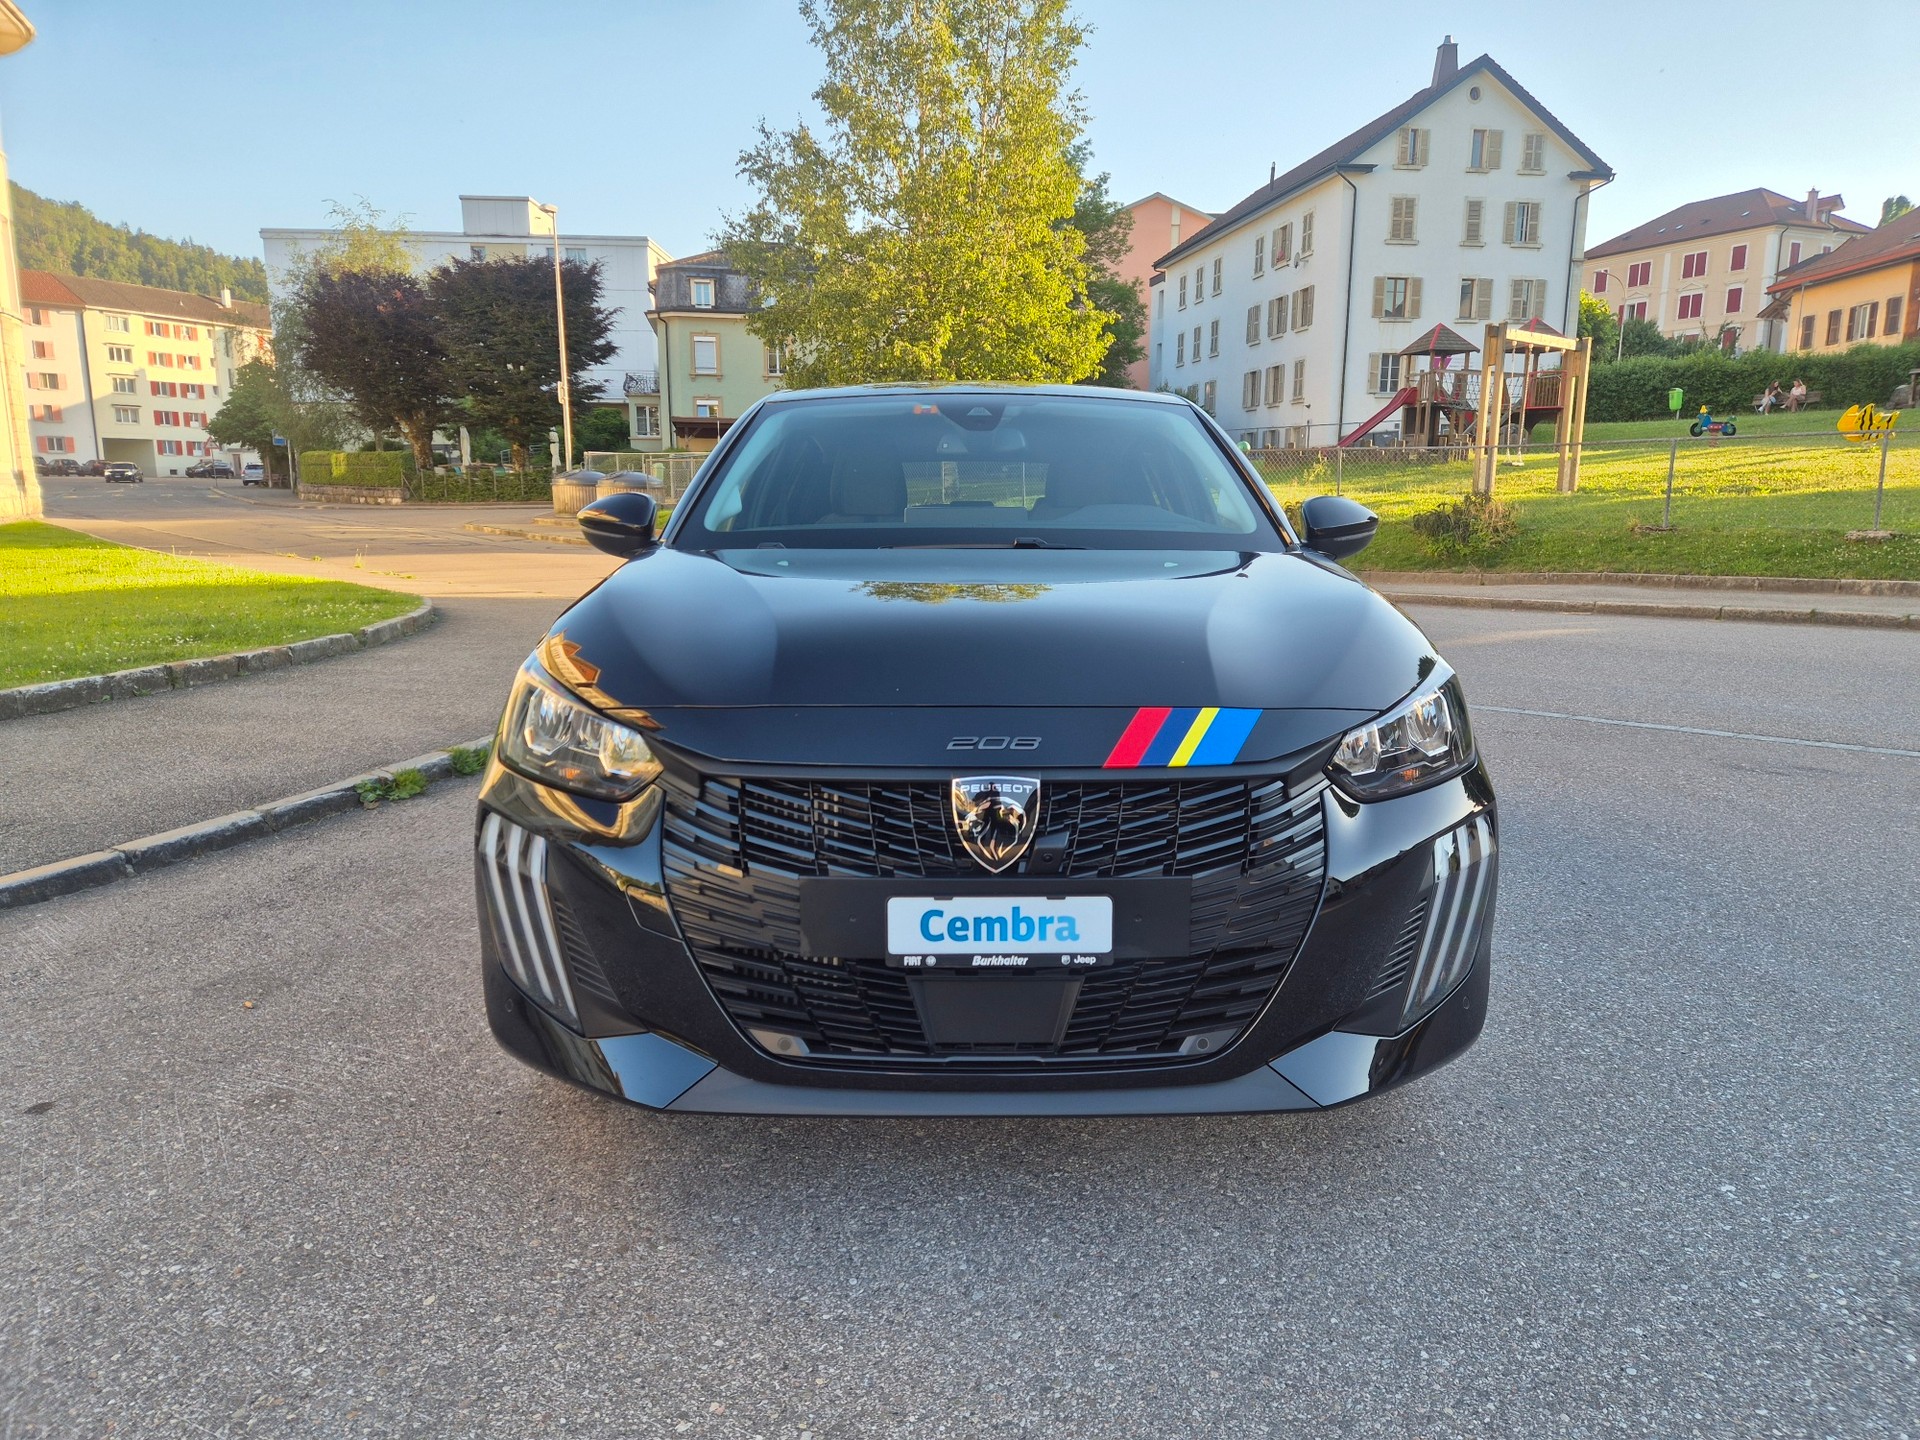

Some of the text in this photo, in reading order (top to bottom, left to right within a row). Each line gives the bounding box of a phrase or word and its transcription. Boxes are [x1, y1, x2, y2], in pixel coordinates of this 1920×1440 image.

[946, 736, 1042, 750] 208
[961, 783, 1033, 793] PEUGEOT
[920, 906, 1080, 942] Cembra
[904, 955, 1097, 966] FIAT Burkhalter Jeep
